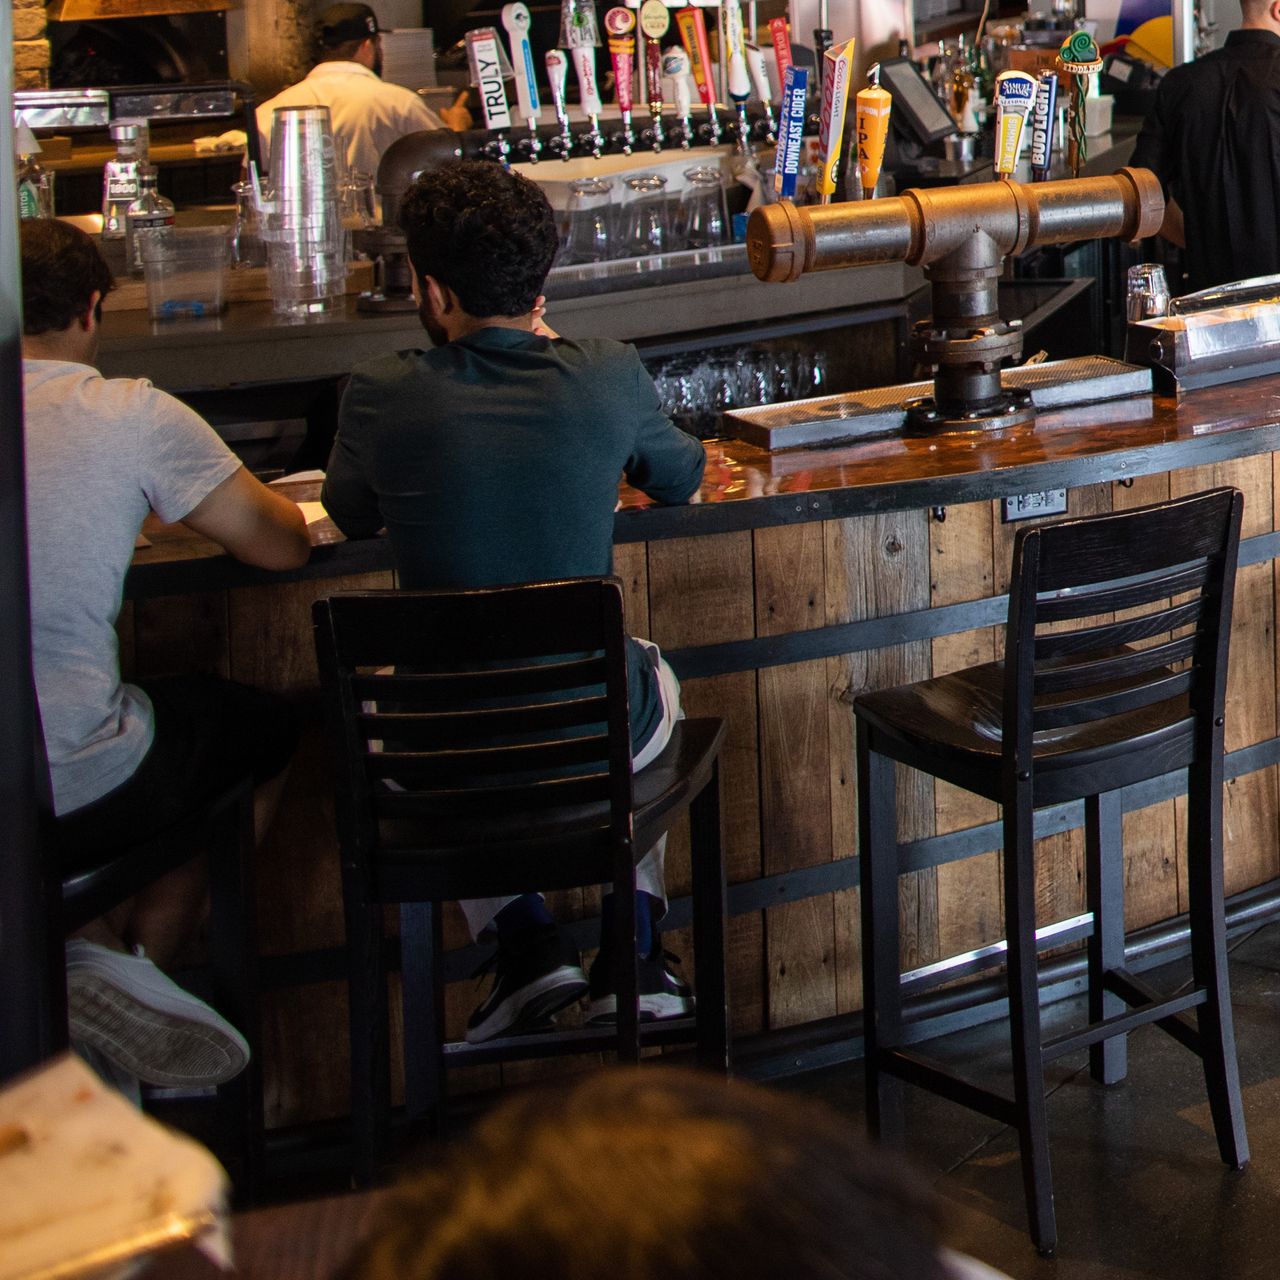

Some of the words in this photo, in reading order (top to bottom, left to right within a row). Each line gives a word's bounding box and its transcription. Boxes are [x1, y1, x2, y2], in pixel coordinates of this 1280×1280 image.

[478, 59, 507, 121] TRULY
[1002, 80, 1032, 91] SAMUEL
[1003, 88, 1029, 97] ADAMS
[790, 88, 806, 118] CIDER
[1034, 83, 1050, 130] LIGHT
[784, 120, 804, 174] DOWNEAST
[858, 117, 870, 160] IPA
[1032, 132, 1047, 166] BUD
[110, 183, 137, 194] 1800
